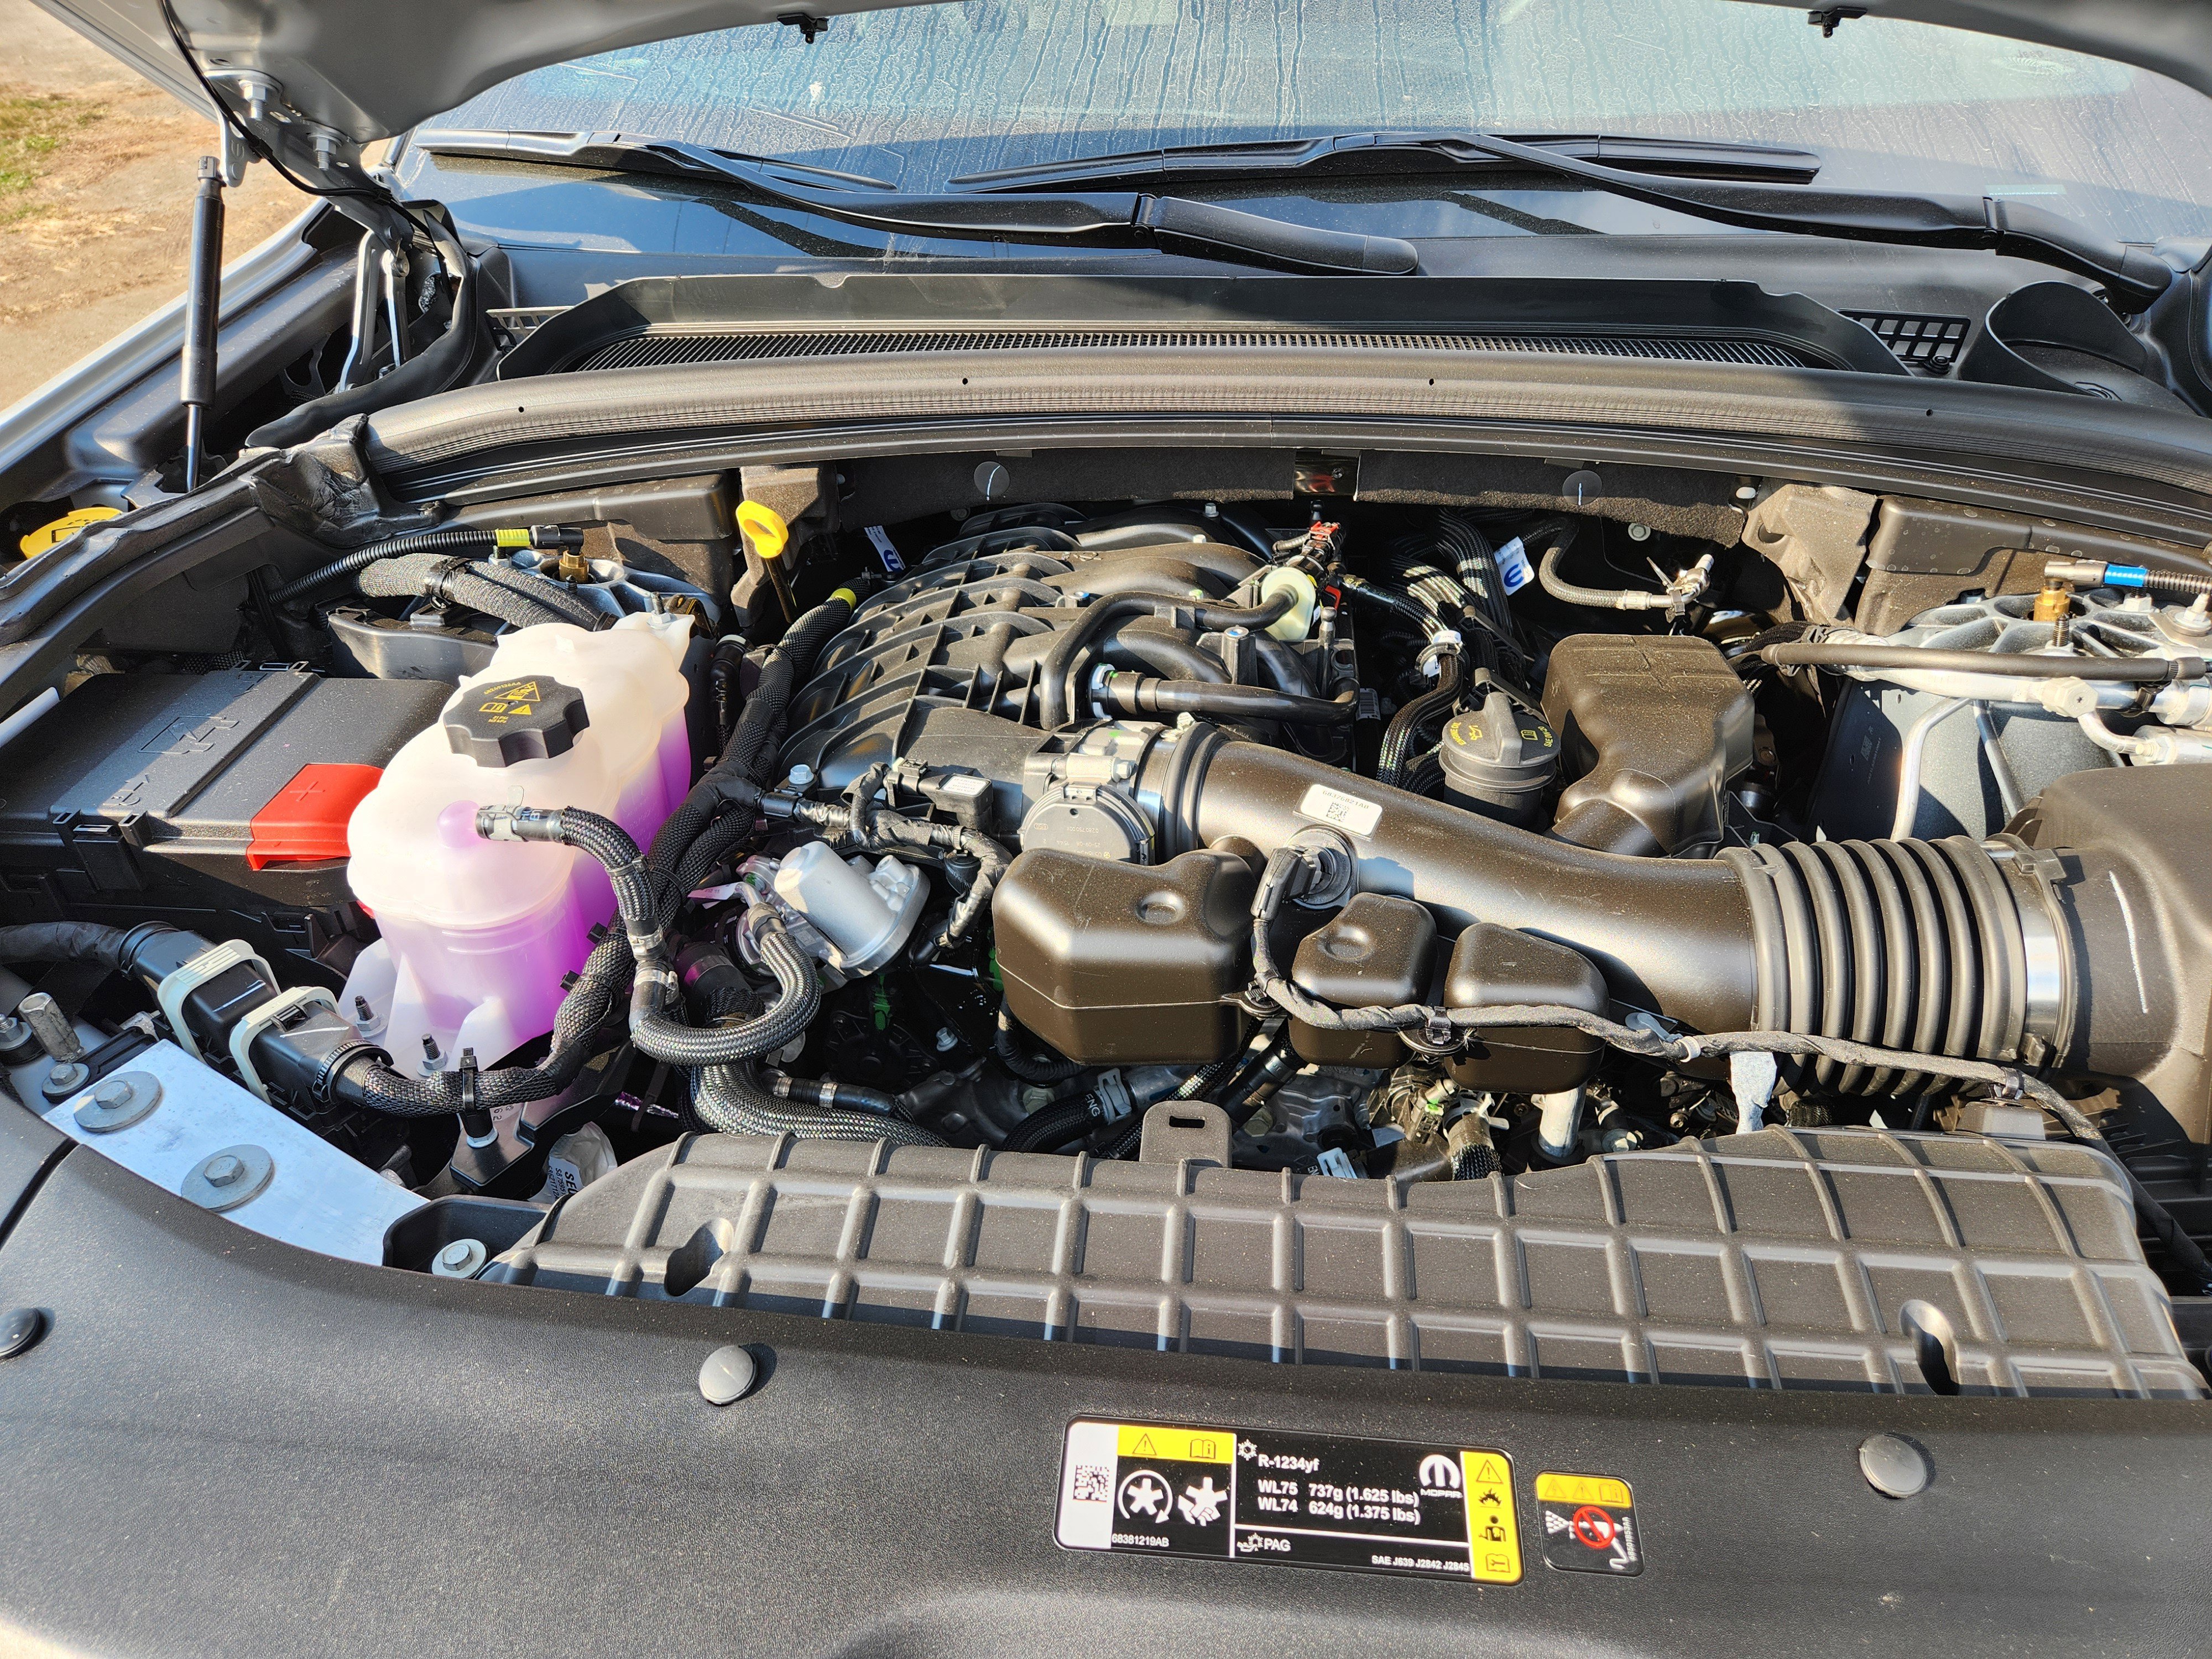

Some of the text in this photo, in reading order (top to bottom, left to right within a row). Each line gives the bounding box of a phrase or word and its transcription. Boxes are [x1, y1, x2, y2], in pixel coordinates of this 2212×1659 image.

[1451, 728, 1467, 745] ENGINE
[1543, 738, 1553, 747] SAE
[1085, 1093, 1100, 1117] ENG
[1258, 1454, 1319, 1473] R-1234yf
[1258, 1479, 1420, 1507] WL75 737g (1.625 lbs)
[1420, 1488, 1463, 1499] MOPAR
[1258, 1496, 1421, 1526] WL74 624g (1.375 lbs)
[1112, 1533, 1170, 1547] 68381219AB
[1264, 1537, 1291, 1552] PAG
[1371, 1555, 1470, 1572] SAE J639 J2842 J2845
